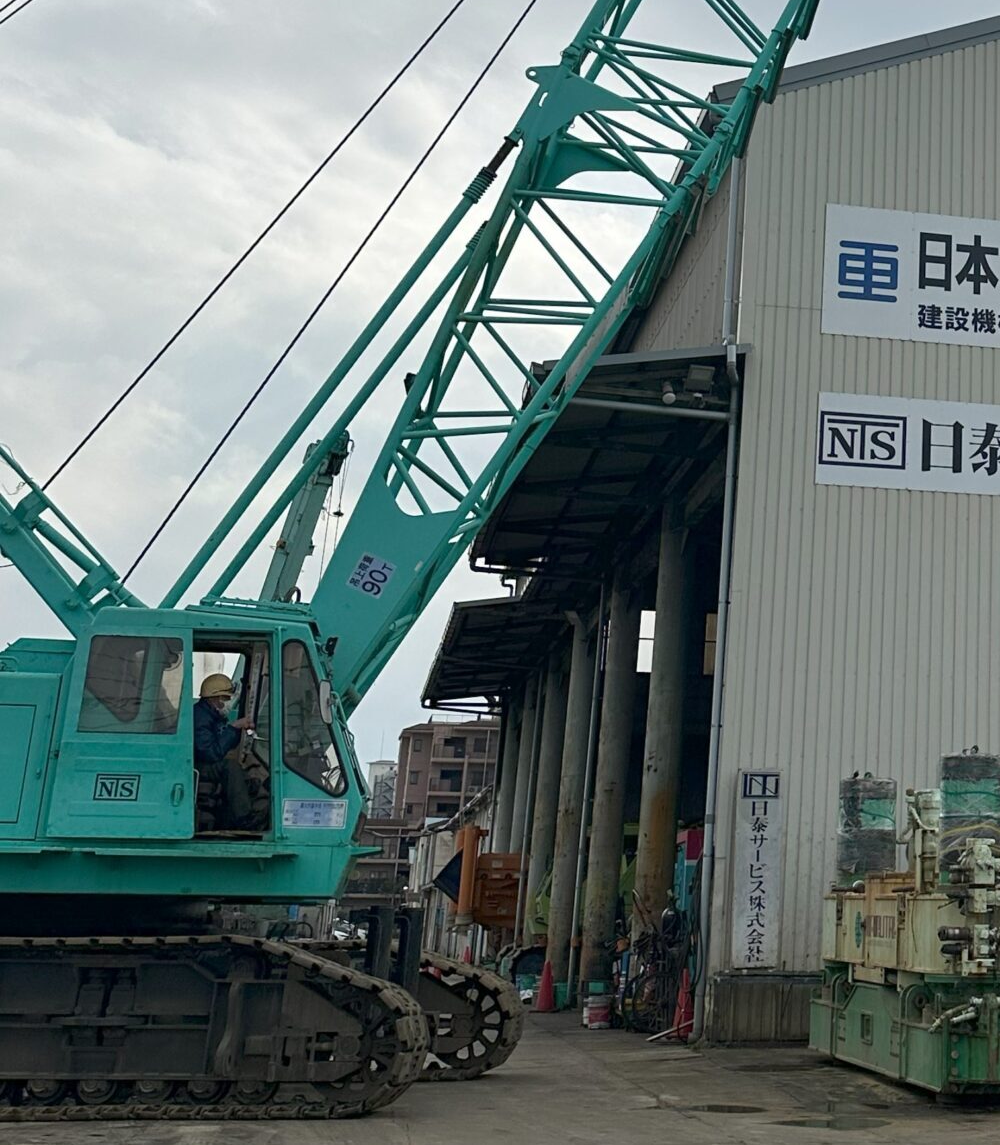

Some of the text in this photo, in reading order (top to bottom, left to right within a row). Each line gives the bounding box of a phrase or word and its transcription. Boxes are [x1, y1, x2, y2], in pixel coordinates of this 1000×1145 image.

[827, 418, 900, 461] NTS
[361, 562, 393, 596] 90T
[97, 777, 137, 798] NTS
[744, 801, 769, 963] 日泰サービス株式会社
